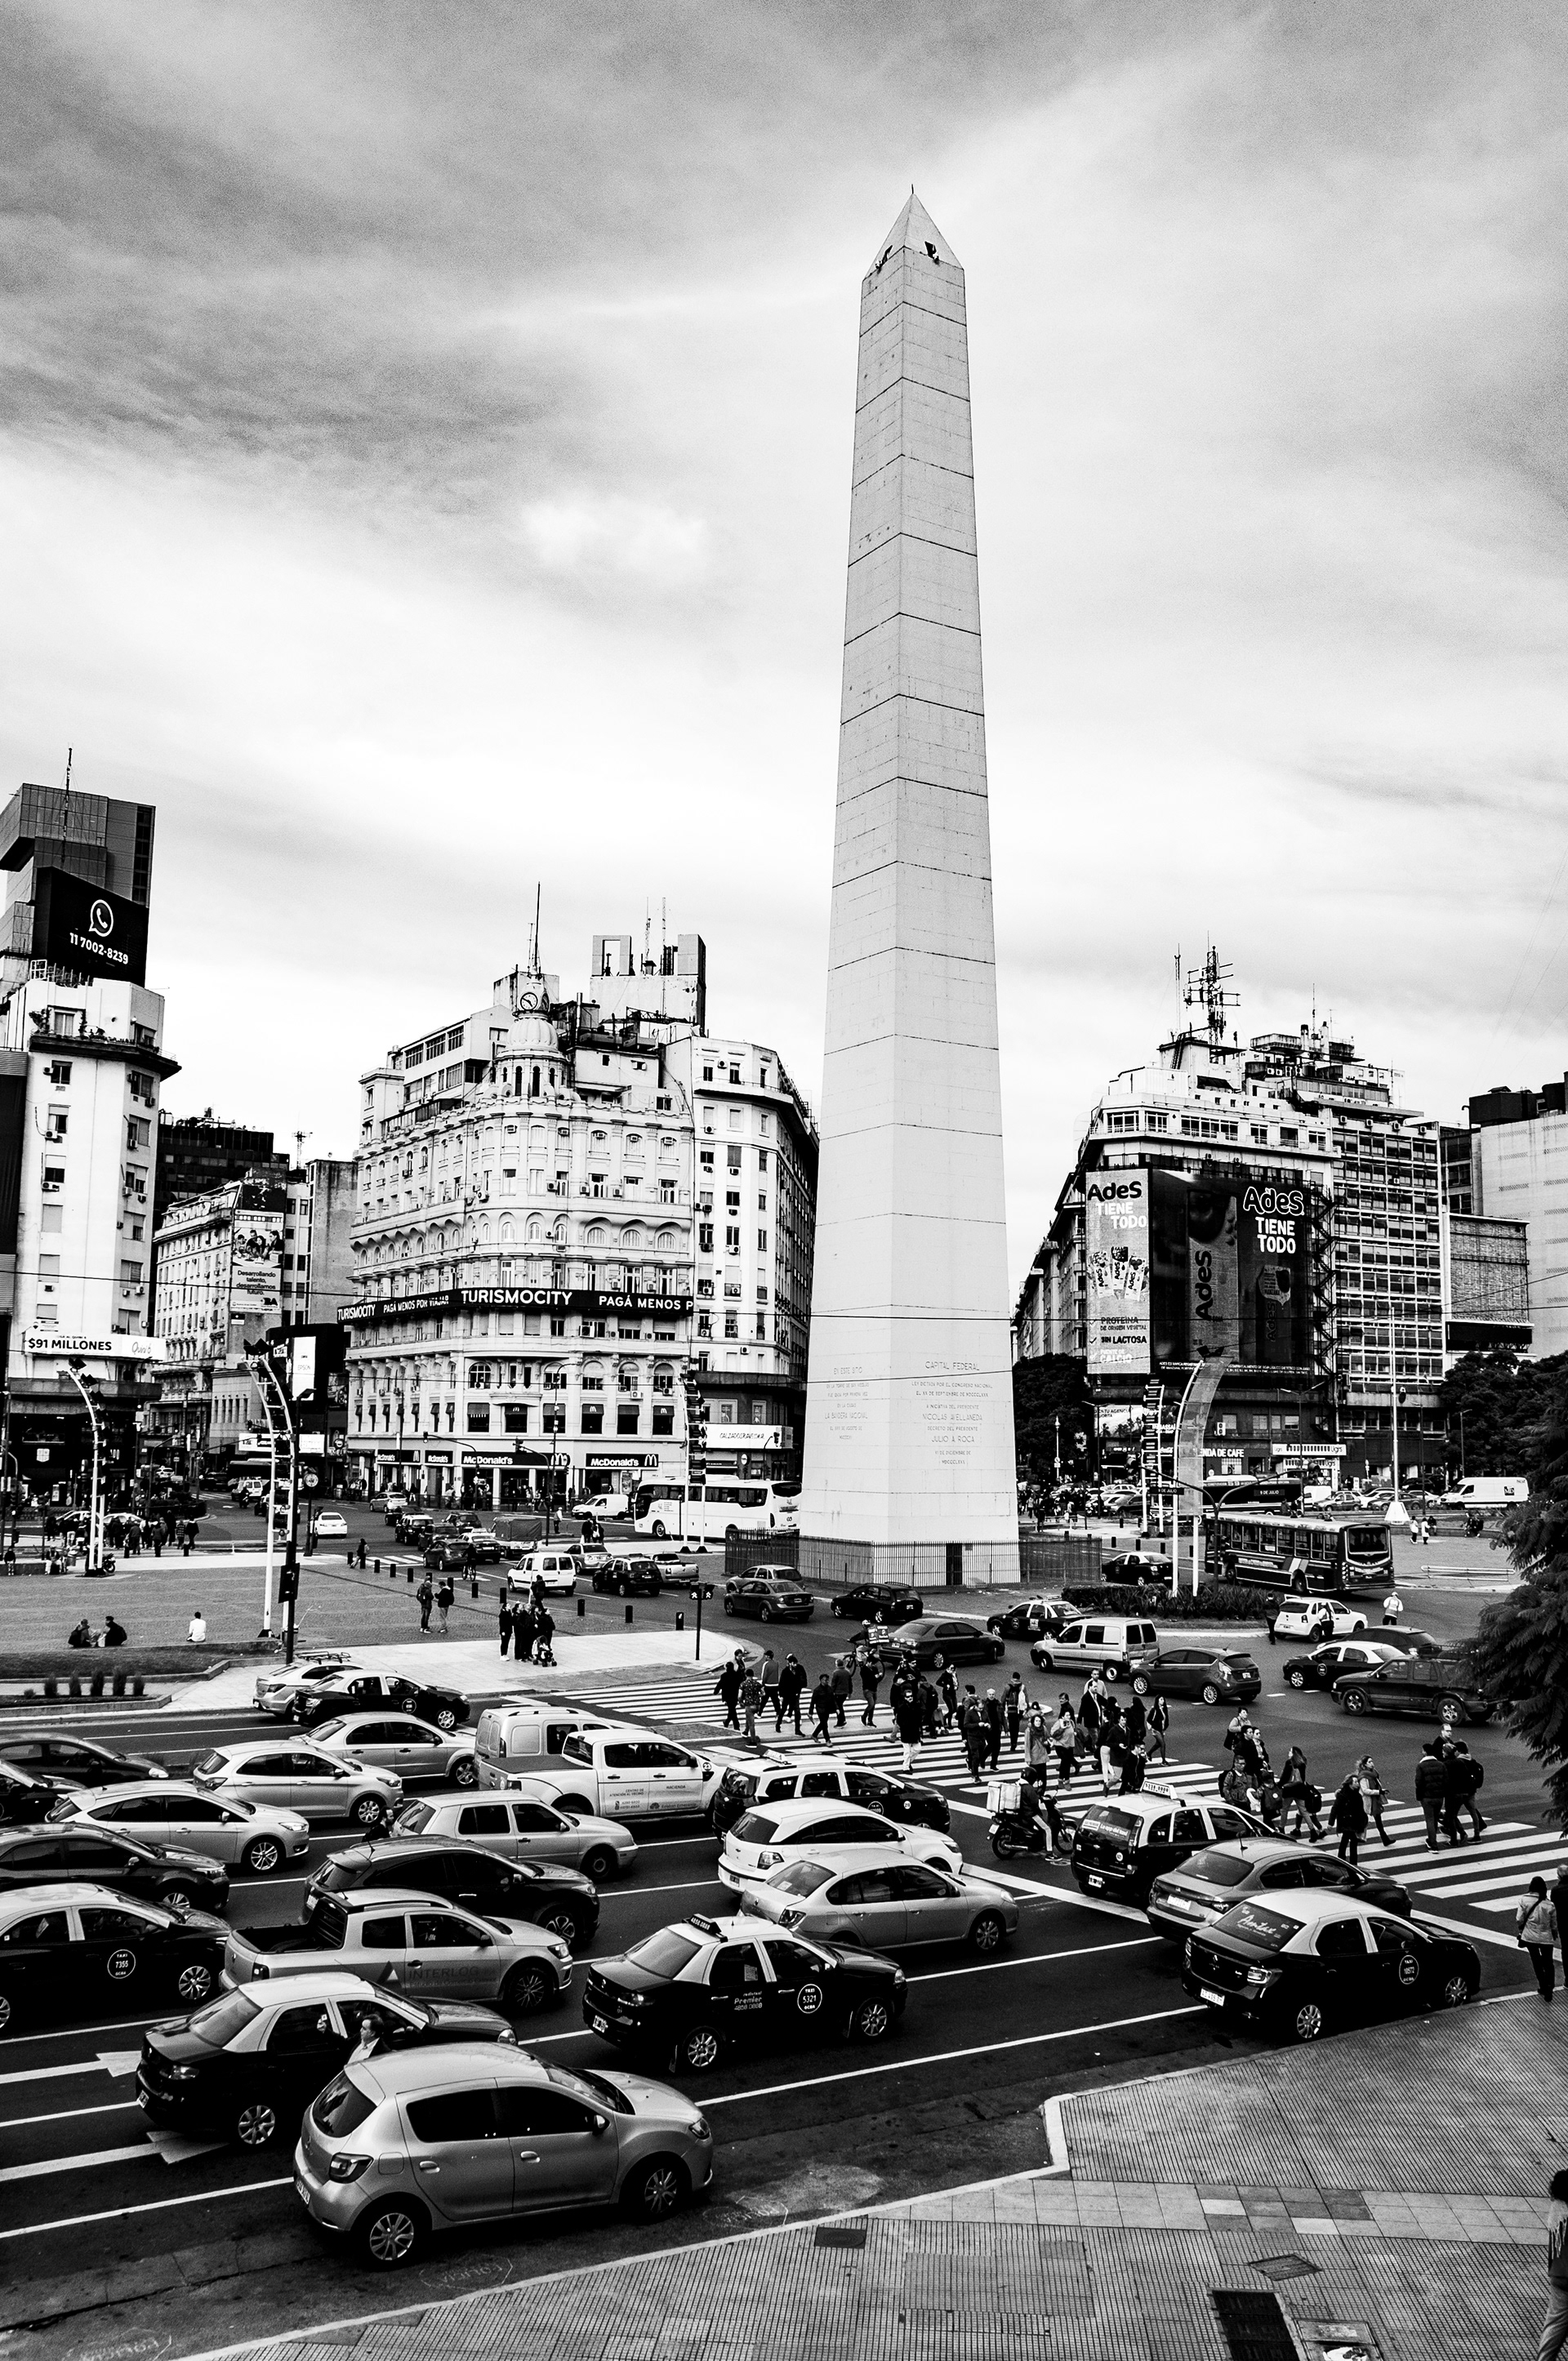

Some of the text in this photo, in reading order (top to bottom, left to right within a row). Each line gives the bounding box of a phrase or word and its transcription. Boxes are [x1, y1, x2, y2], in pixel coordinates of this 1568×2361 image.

[69, 933, 129, 964] 11 7002-8239
[1087, 1181, 1143, 1202] AdeS
[1243, 1186, 1304, 1216] AdeS
[1095, 1202, 1134, 1216] TIENE
[1111, 1215, 1147, 1229] TODO
[1255, 1217, 1295, 1236] TIENE
[1257, 1234, 1296, 1254] TODO
[1195, 1250, 1214, 1321] AdeS
[461, 1290, 572, 1306] TURISMOCITY
[599, 1294, 633, 1307] PAGÁ
[637, 1298, 681, 1310] MENOS
[337, 1304, 376, 1321] TURISMOCITY
[28, 1338, 112, 1351] $91 MILLONES
[1112, 1336, 1147, 1344] LACTOSA
[952, 1361, 980, 1371] FEDERAL
[957, 1435, 975, 1443] ROCA
[1217, 1448, 1227, 1457] DE
[463, 1455, 513, 1465] McDonald's
[590, 1458, 639, 1467] McDonald's
[115, 1960, 129, 1969] 7355
[409, 1966, 479, 1980] INTERLOG
[734, 1996, 763, 2005] Premier
[802, 1994, 817, 2004] 5321
